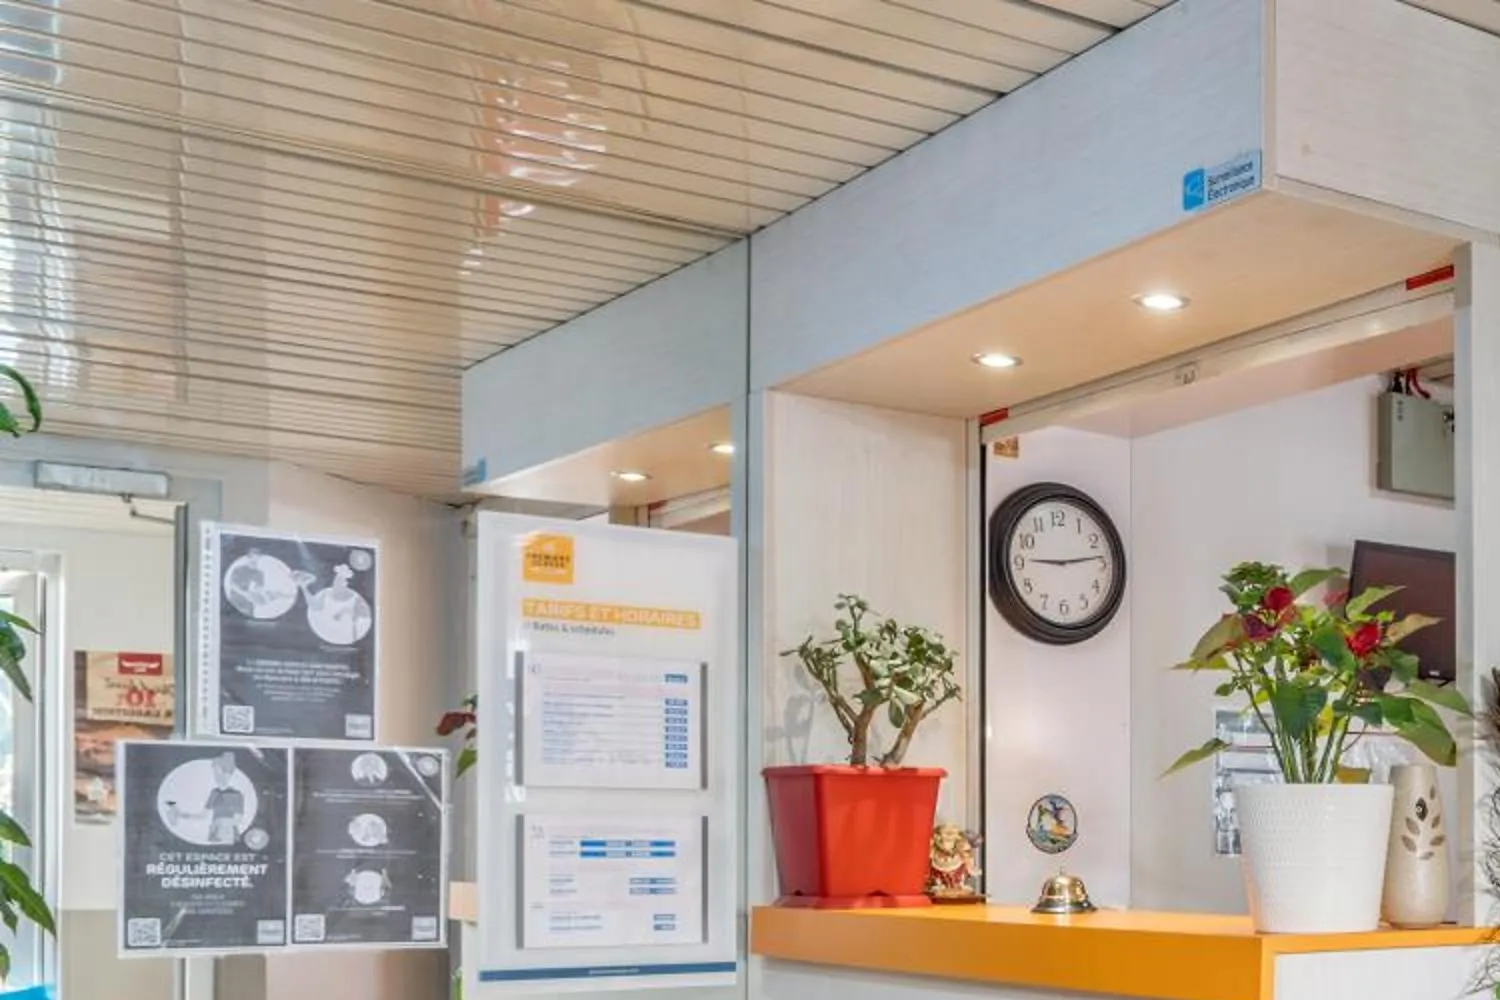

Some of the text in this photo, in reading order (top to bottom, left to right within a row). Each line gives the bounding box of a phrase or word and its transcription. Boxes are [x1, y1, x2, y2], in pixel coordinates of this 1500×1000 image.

[1051, 510, 1065, 527] 12
[1019, 532, 1035, 550] 10
[524, 601, 698, 629] TARIFS ET HORAIRES
[159, 852, 258, 862] CET ESPACE EST
[145, 862, 269, 876] RÉGULIÈREMENT
